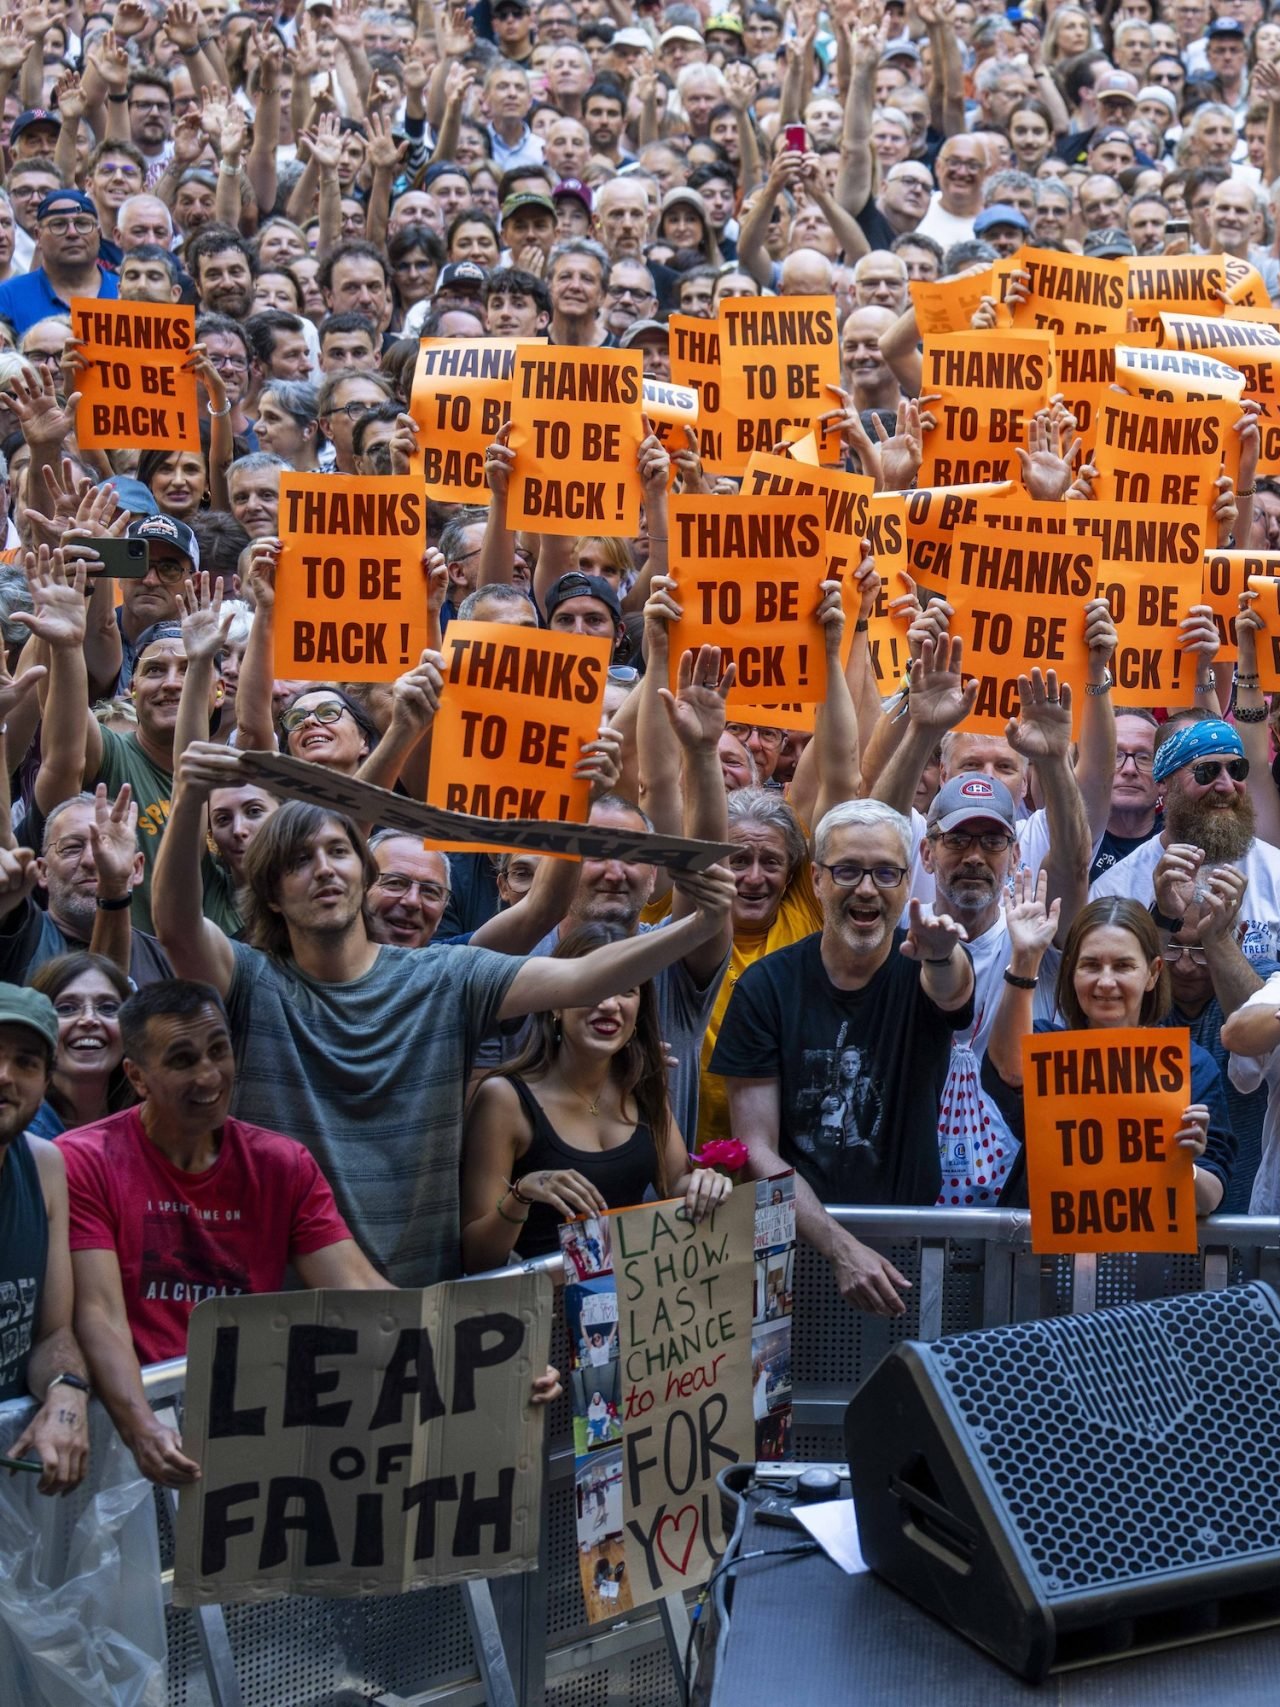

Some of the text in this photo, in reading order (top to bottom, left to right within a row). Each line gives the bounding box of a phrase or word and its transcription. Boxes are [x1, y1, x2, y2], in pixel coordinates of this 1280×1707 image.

[1026, 261, 1124, 309] THANKS
[1128, 268, 1222, 301] THANKS
[77, 312, 190, 351] THANKS
[674, 328, 720, 365] THA
[725, 311, 833, 345] THANKS
[96, 360, 175, 396] TO BE
[425, 349, 516, 381] THANK
[521, 361, 637, 404] THANKS
[743, 365, 819, 399] TO BE
[930, 350, 1043, 390] THANKS
[1056, 349, 1115, 382] HAN
[1122, 351, 1240, 381] THANKS
[1239, 363, 1275, 393] BE
[435, 394, 470, 432] TO
[642, 384, 693, 410] NKS
[533, 420, 620, 462] TO BE
[944, 406, 1023, 442] TO BE
[1105, 407, 1219, 455] THANKS
[425, 448, 489, 489] BAC
[1113, 469, 1200, 505] TO BE
[286, 490, 420, 535] THANKS
[676, 513, 819, 558] THANKS
[303, 557, 401, 600] TO BE
[960, 542, 1095, 597] THANKS
[698, 581, 798, 624] TO BE
[1138, 585, 1178, 627] BE
[972, 610, 1066, 660] TO BE
[449, 640, 601, 704] THANKS
[462, 711, 569, 768] TO BE
[1031, 1046, 1183, 1096] THANKS
[1056, 1119, 1166, 1166] TO BE
[630, 1275, 720, 1347] LAST
[627, 1311, 736, 1382] CHANCE
[208, 1313, 525, 1439] LEAP
[624, 1354, 727, 1420] to hear
[330, 1443, 411, 1484] OF
[626, 1393, 740, 1508] FOR
